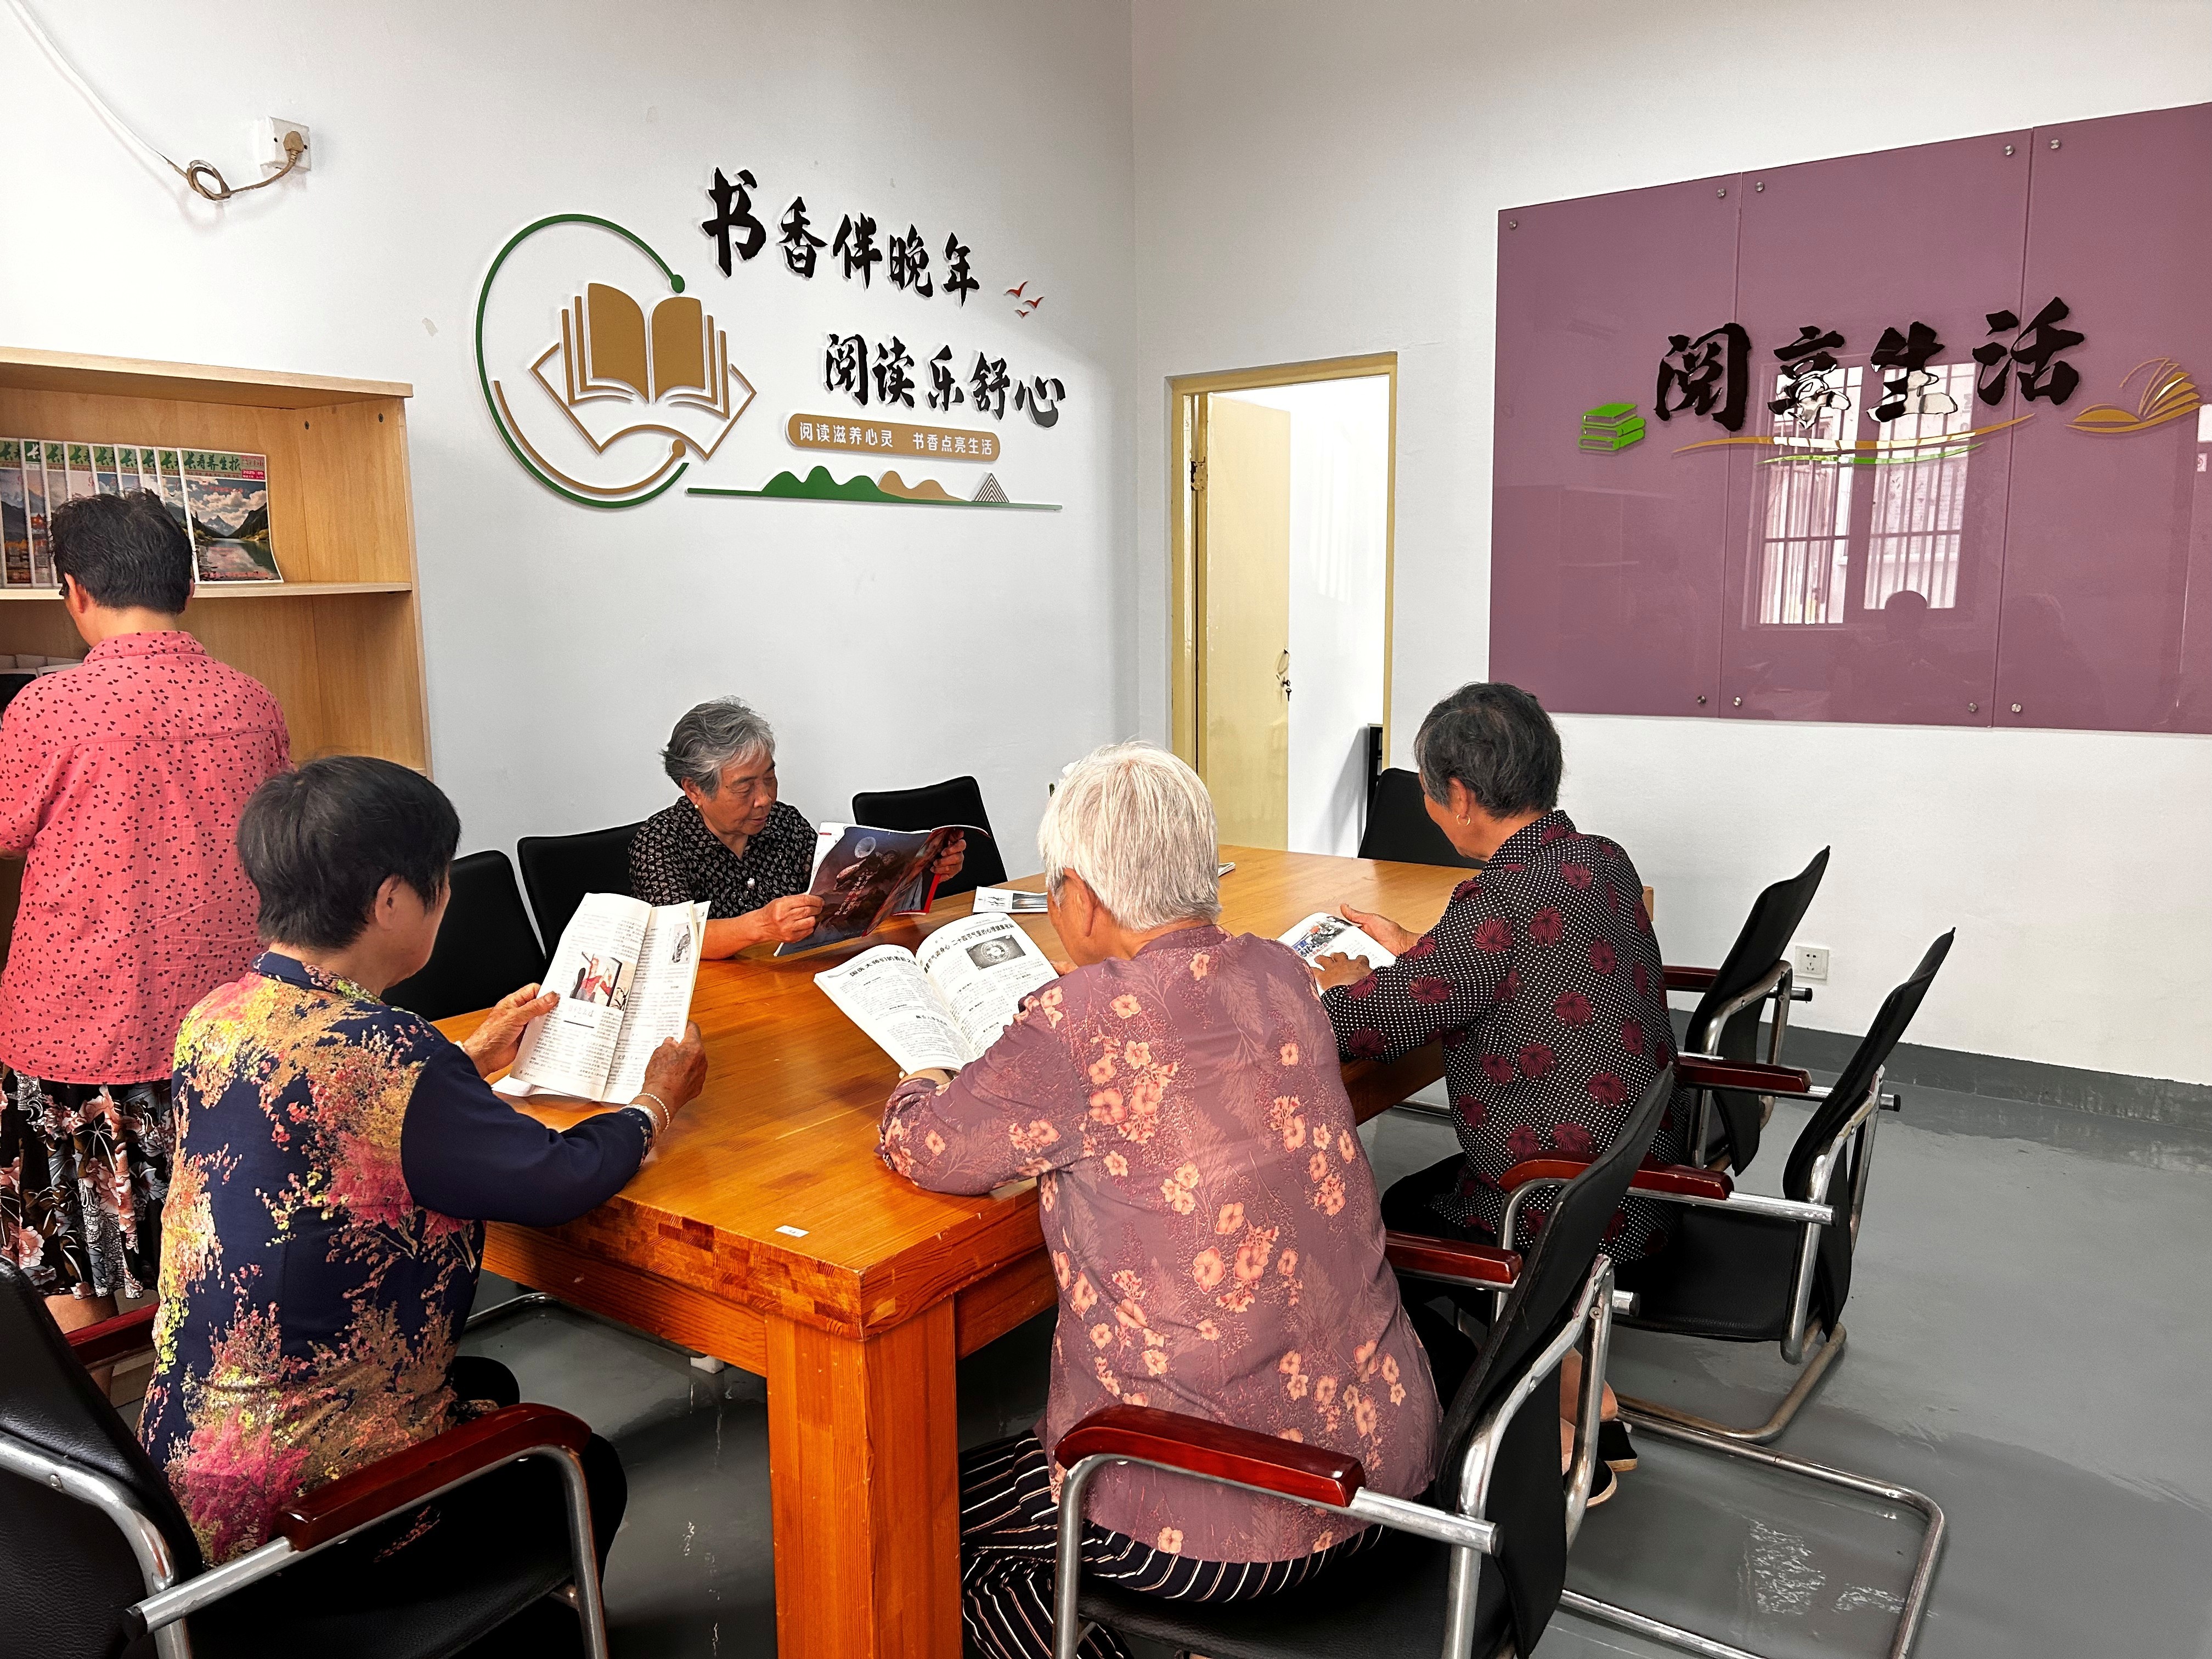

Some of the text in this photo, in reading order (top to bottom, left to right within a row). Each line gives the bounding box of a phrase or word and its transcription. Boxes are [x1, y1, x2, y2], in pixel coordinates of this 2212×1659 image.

[702, 167, 980, 307] 书香伴晚年
[826, 334, 1065, 427] 阅读乐舒心
[1654, 297, 2084, 431] 阅享生活
[800, 422, 992, 455] 阅读滋养心灵 书香点亮生活
